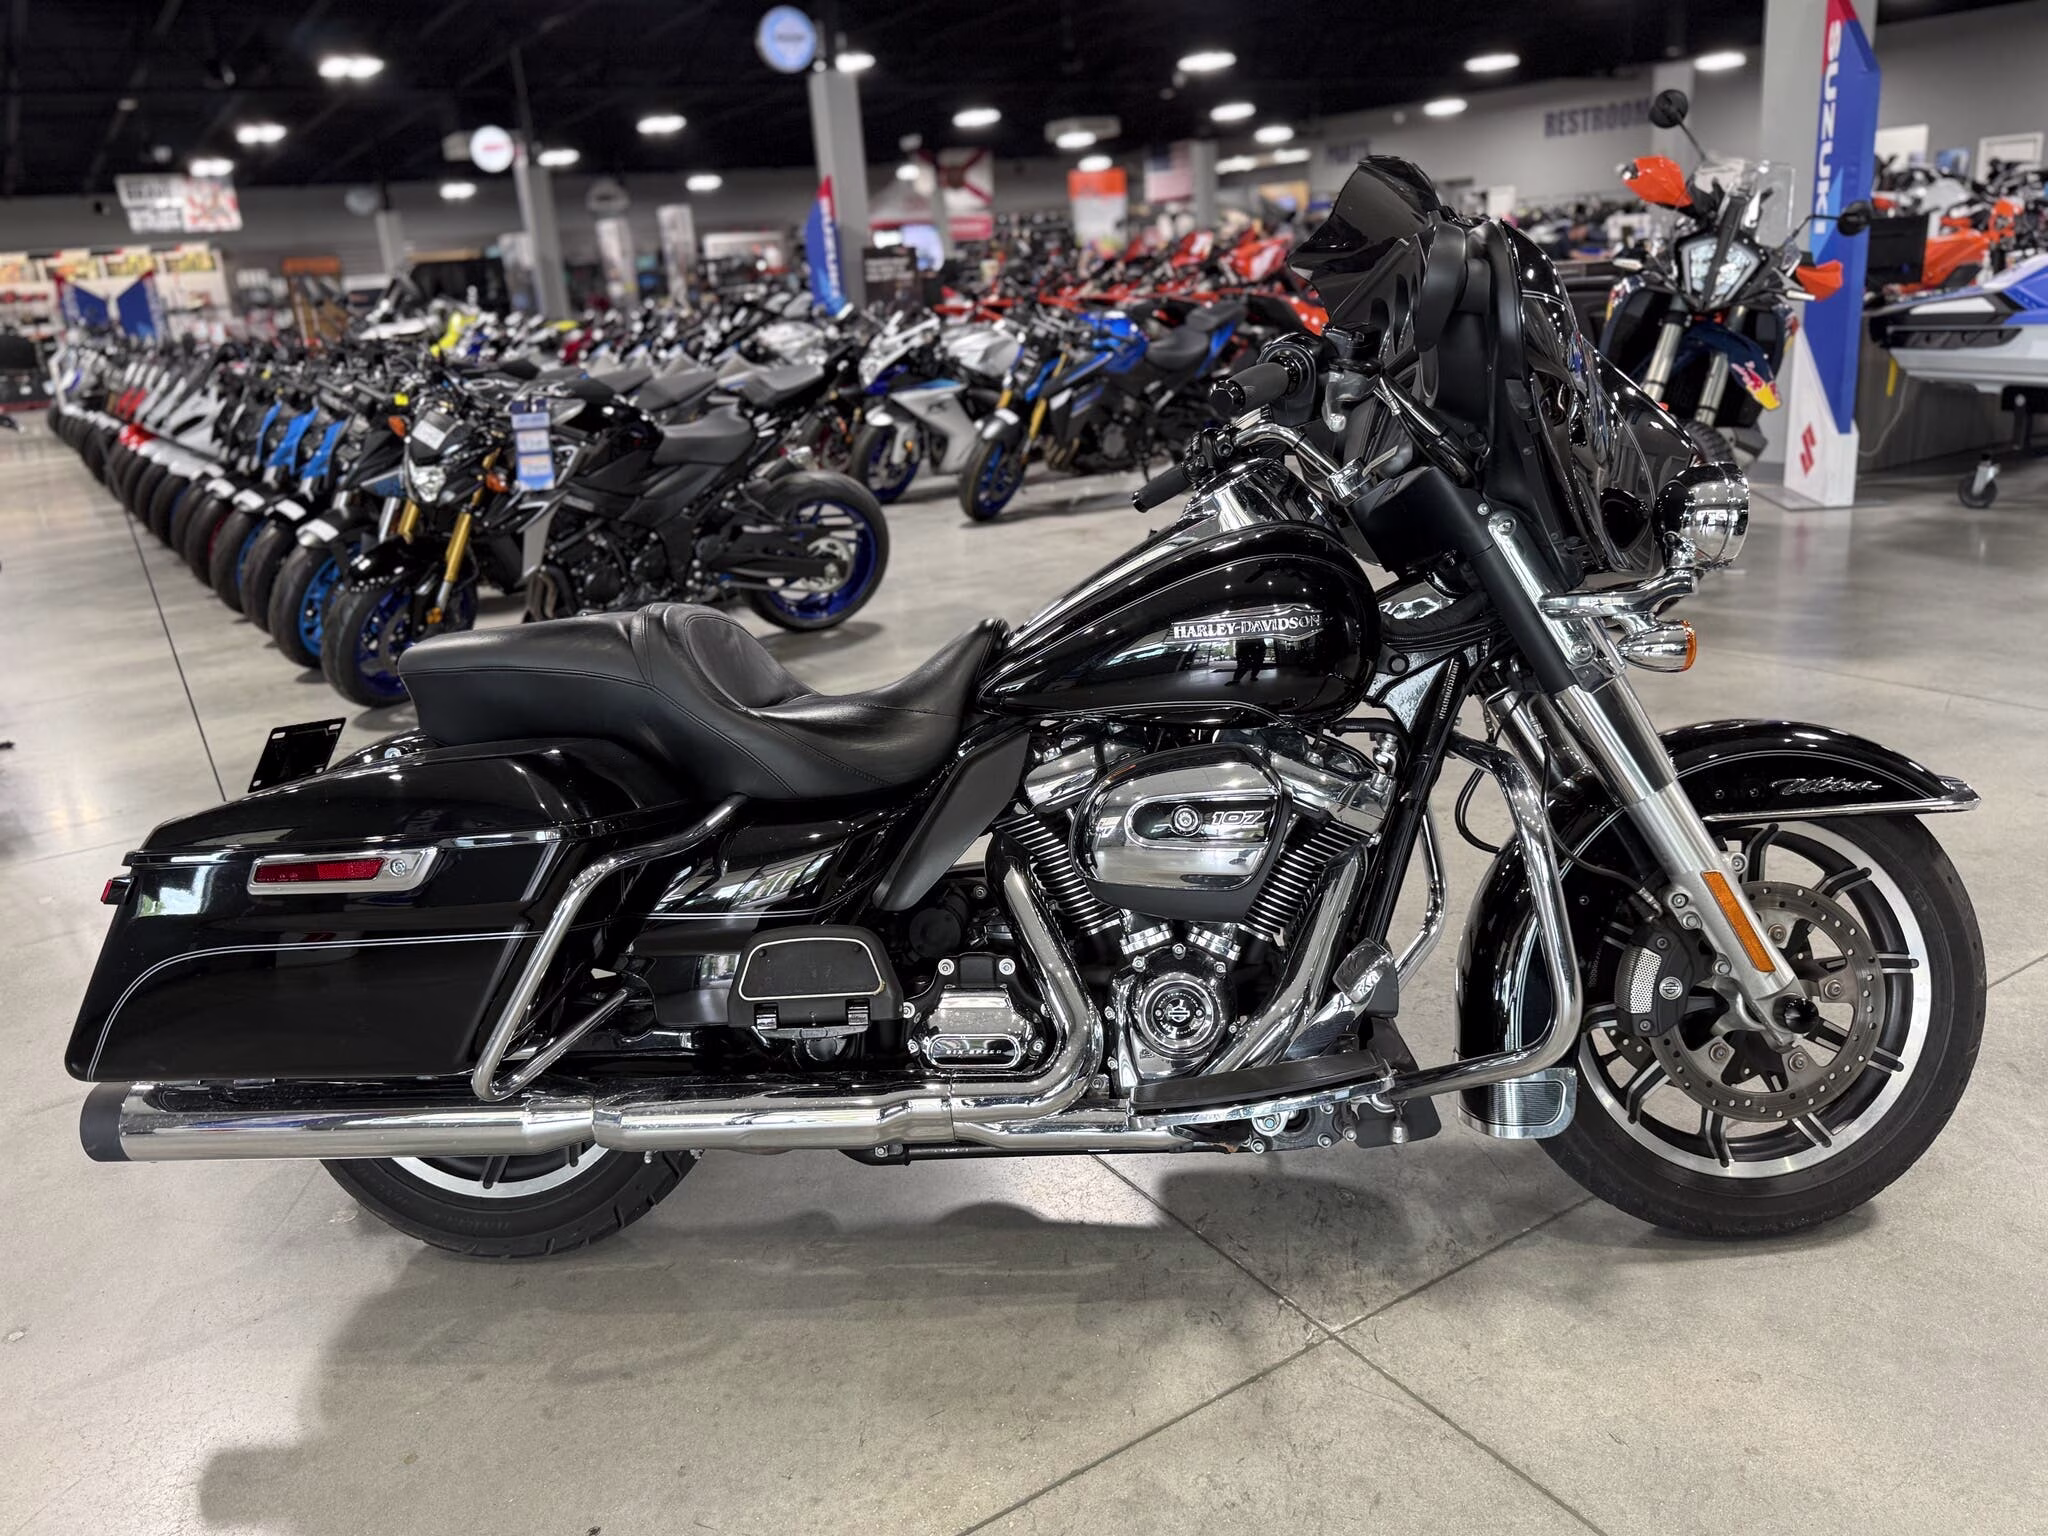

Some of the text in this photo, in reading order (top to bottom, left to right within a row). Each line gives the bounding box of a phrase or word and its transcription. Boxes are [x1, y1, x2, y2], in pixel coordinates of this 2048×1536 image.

[1814, 19, 1842, 235] SUZUKI
[1173, 614, 1320, 639] HARLEY-DAVIDSON
[1211, 810, 1265, 825] 107
